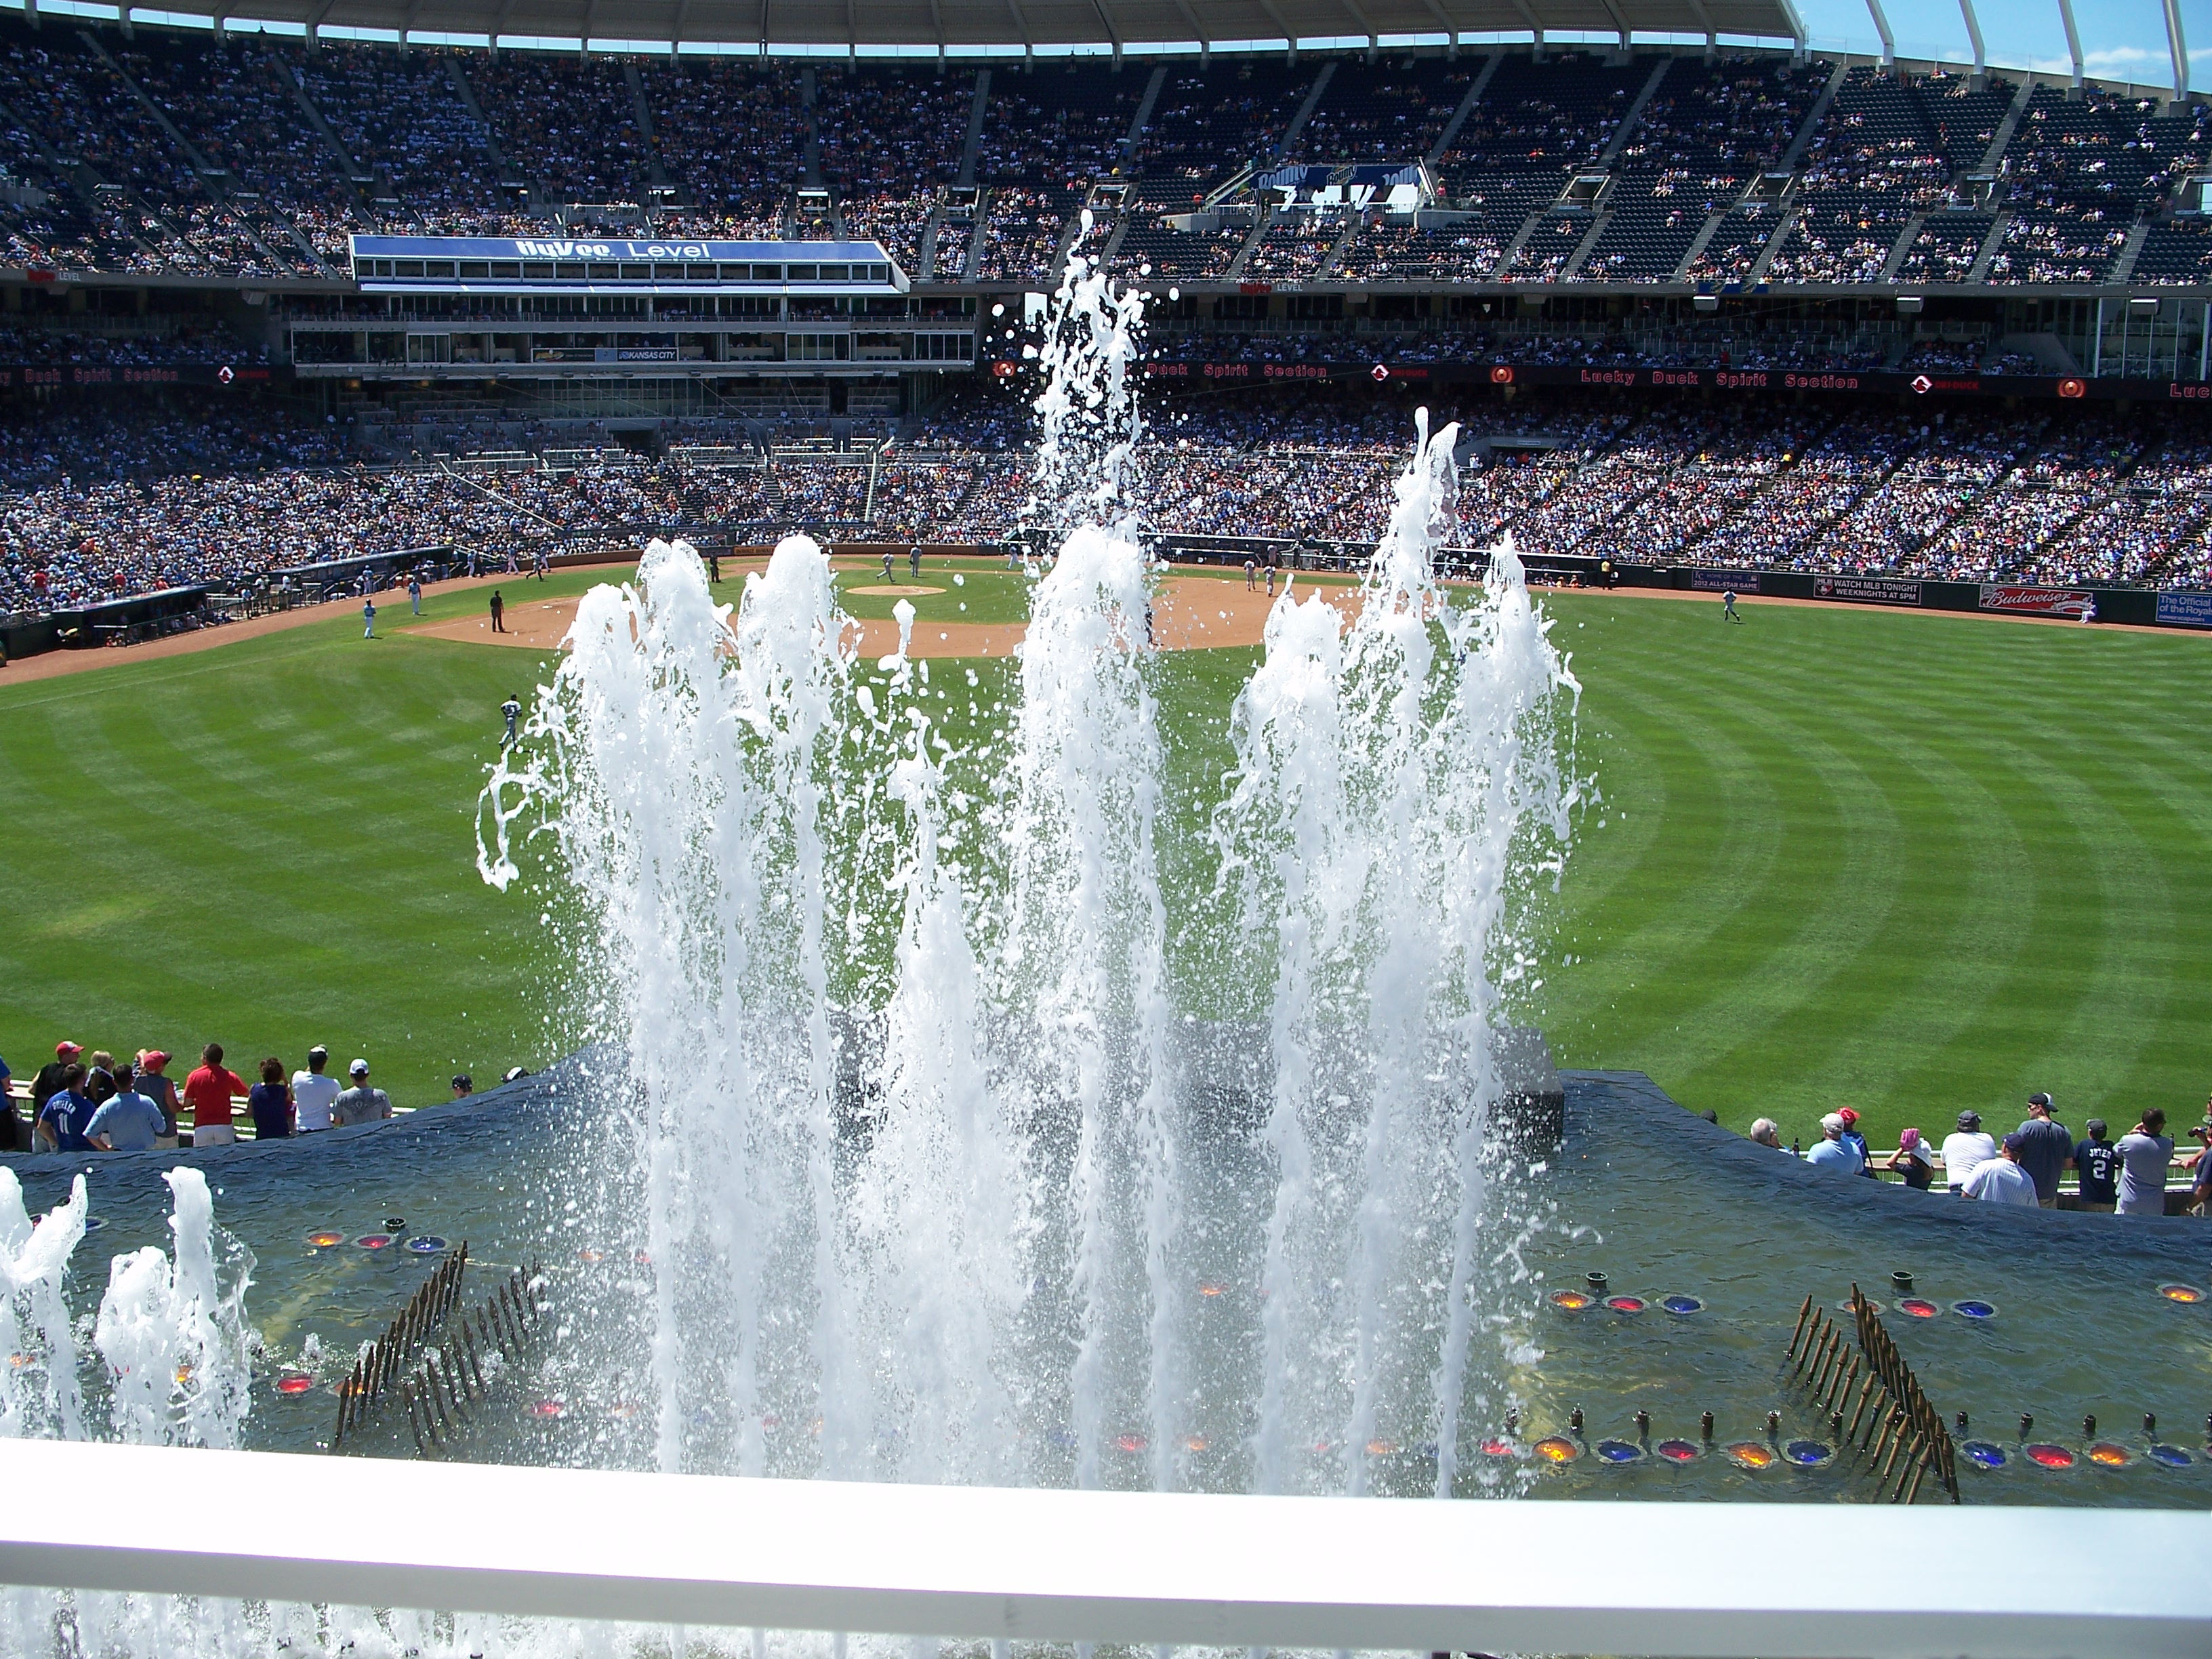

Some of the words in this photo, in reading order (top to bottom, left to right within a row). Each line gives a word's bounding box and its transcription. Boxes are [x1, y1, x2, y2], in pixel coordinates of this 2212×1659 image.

[627, 242, 711, 258] Level
[59, 272, 81, 281] LEVEL
[628, 351, 659, 359] KANSAS
[658, 351, 676, 359] CITY
[25, 368, 62, 383] Duck
[74, 367, 112, 384] Spirit
[123, 368, 178, 382] Section
[1147, 362, 1189, 377] Duck
[1204, 363, 1249, 379] Spirit
[1263, 364, 1328, 379] Section
[1580, 369, 1636, 387] Lucky
[1652, 371, 1699, 386] Duck
[1715, 372, 1767, 389] Spirit
[1784, 373, 1859, 390] Section
[2169, 382, 2212, 398] Luc
[1834, 579, 1862, 588] WATCH
[1863, 581, 1881, 590] MLB
[1882, 582, 1919, 592] TONIGHT
[1836, 588, 1887, 598] WEEKNIGHTS
[1900, 592, 1917, 600] 5PM
[1986, 590, 2072, 607] Budweiser
[2160, 595, 2178, 605] The
[2179, 596, 2211, 607] Official
[2159, 604, 2169, 613] of
[2170, 605, 2185, 613] the
[2089, 1148, 2112, 1160] JETER
[2093, 1160, 2106, 1179] 2
